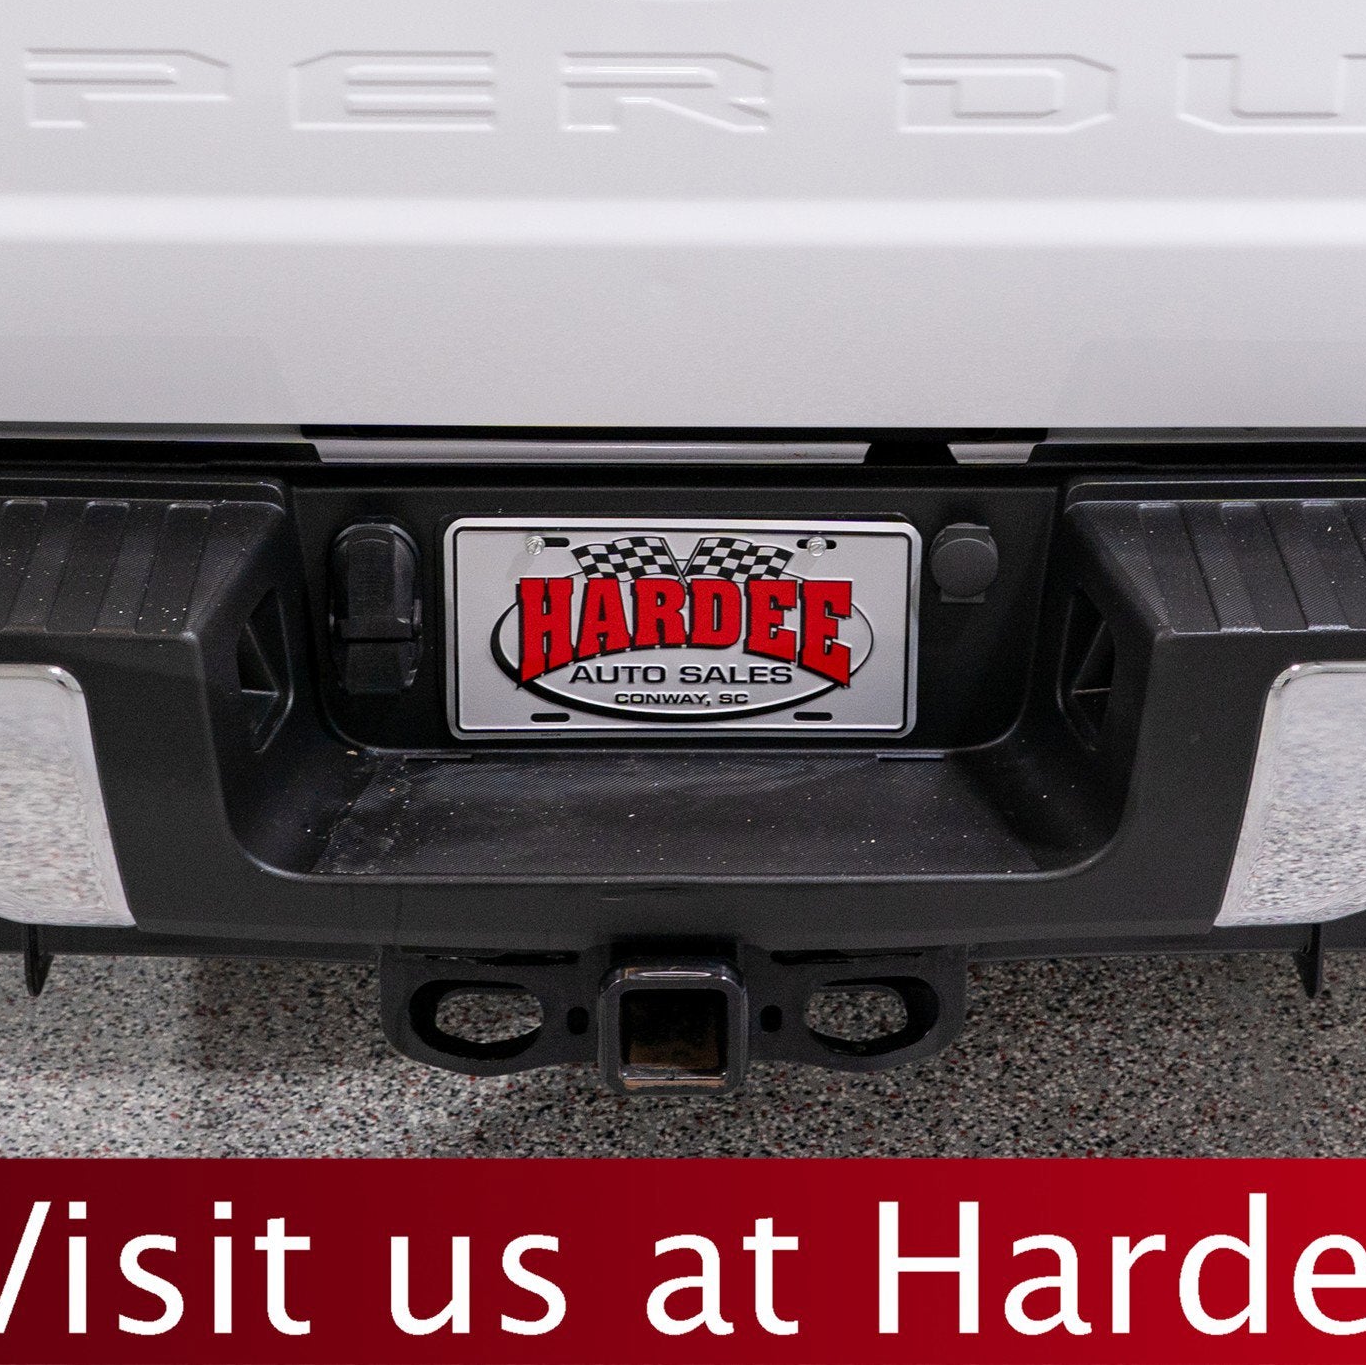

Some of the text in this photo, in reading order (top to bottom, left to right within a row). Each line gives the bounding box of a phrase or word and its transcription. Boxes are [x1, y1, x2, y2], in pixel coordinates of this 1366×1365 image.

[515, 576, 854, 689] HARDEE
[568, 664, 794, 686] AUTO SALES
[613, 691, 749, 707] CONWAY, SC
